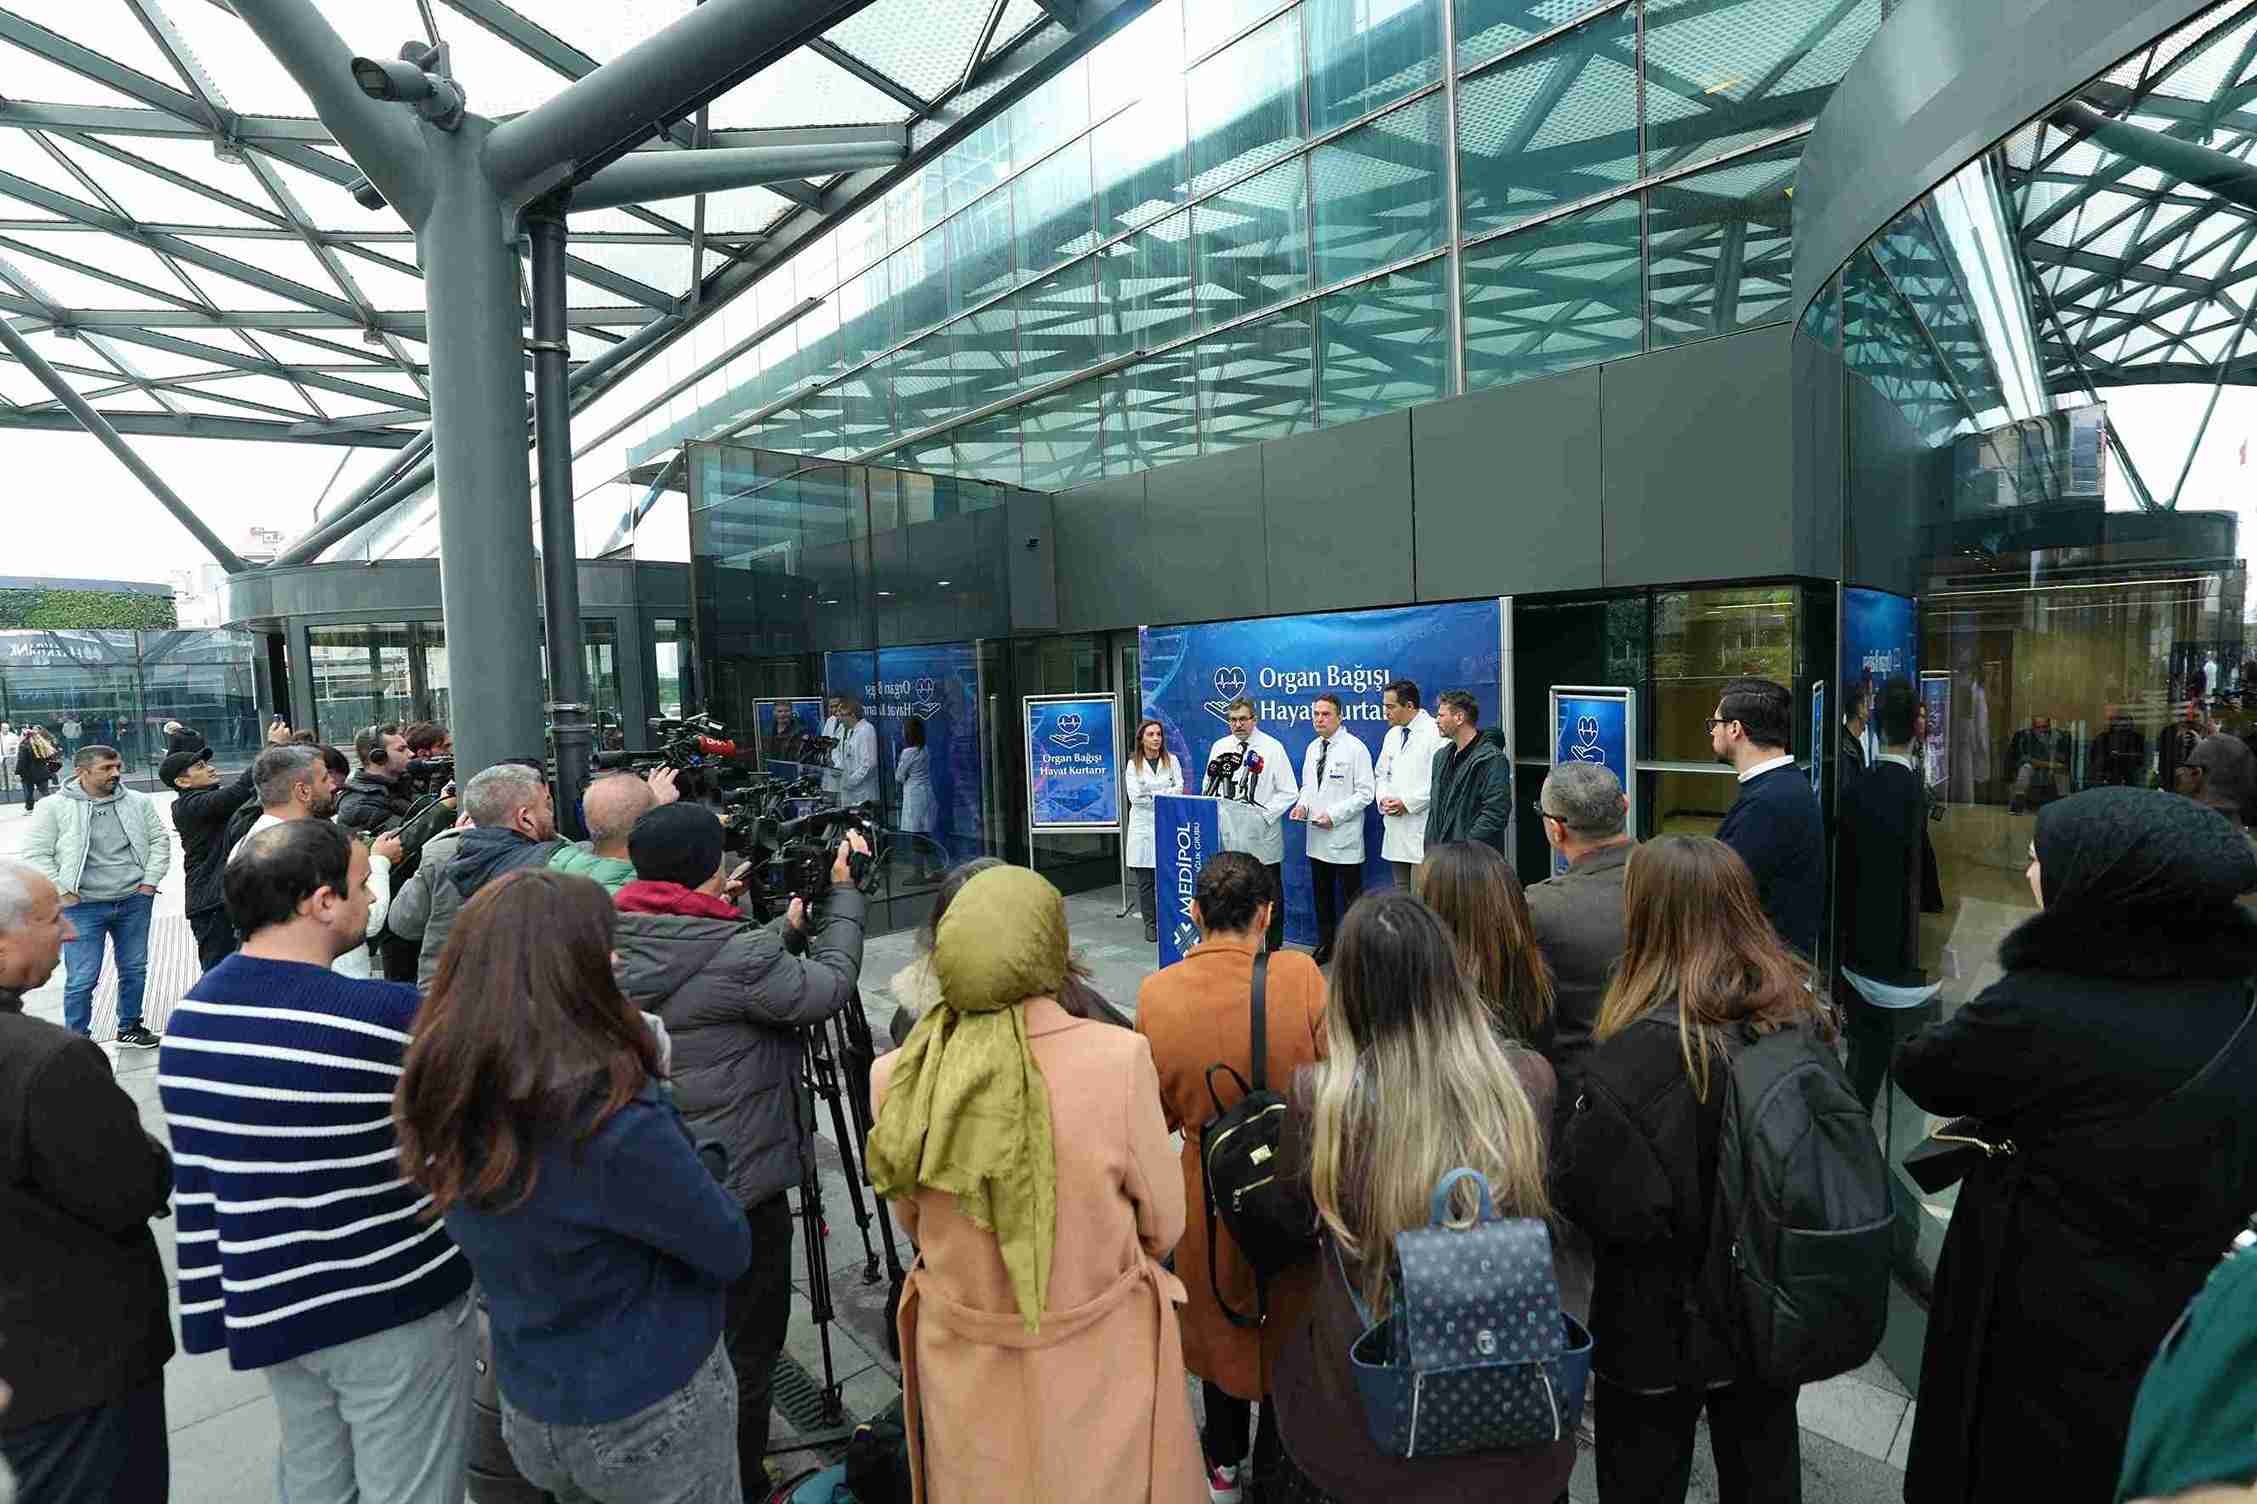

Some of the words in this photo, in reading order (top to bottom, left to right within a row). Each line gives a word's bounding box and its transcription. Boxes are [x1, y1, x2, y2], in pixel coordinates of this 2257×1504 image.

[1259, 667, 1320, 694] Organ
[1328, 664, 1390, 692] Bağışı
[1260, 700, 1312, 723] Haya
[1042, 754, 1072, 765] Organ
[1074, 753, 1103, 764] Bağışı
[1040, 767, 1067, 778] Hayat
[1069, 766, 1106, 776] Kurtarır
